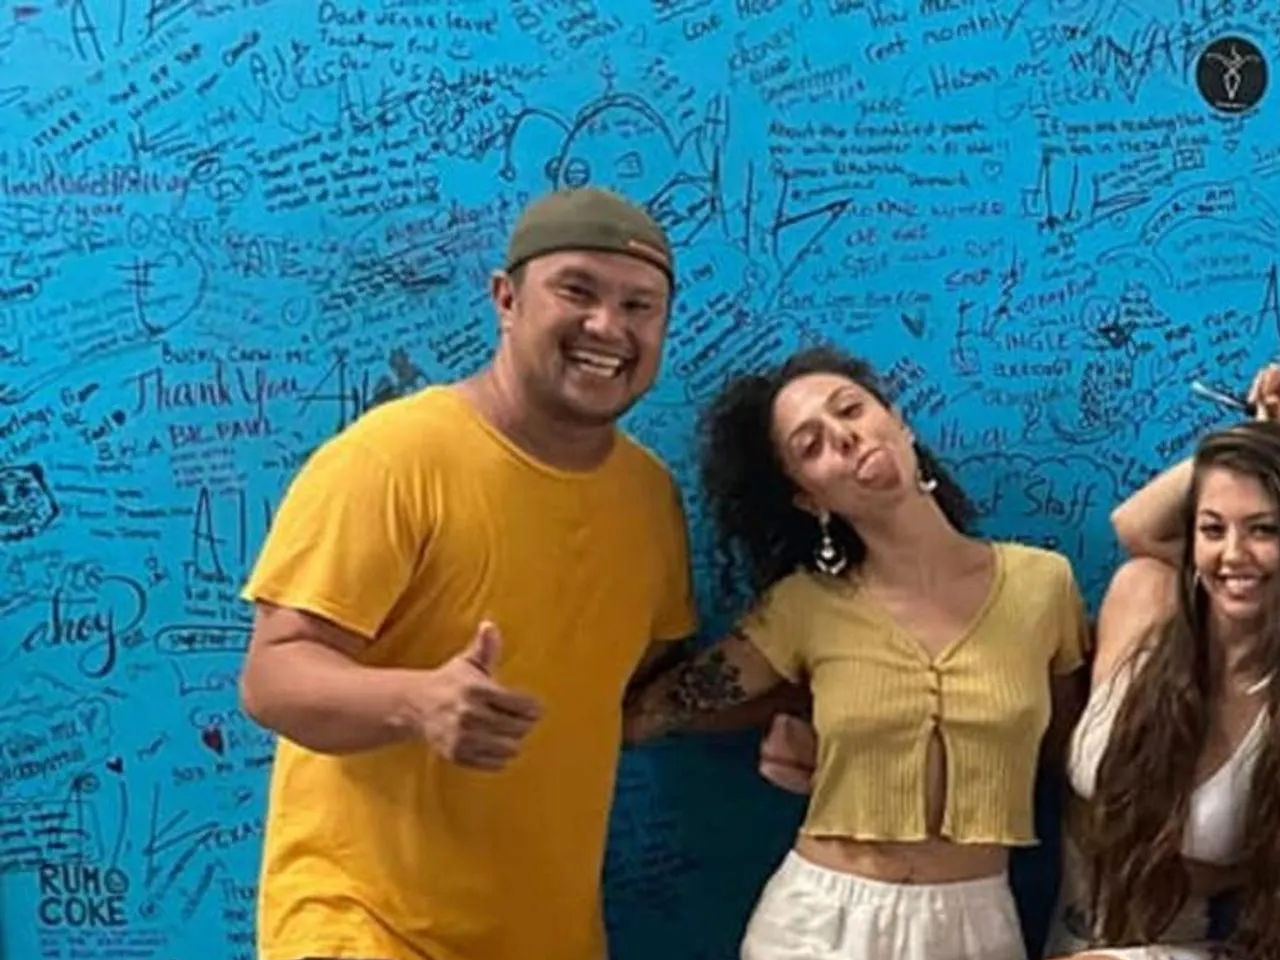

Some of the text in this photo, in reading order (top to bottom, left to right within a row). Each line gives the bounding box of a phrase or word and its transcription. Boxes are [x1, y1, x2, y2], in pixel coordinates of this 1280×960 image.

[122, 360, 299, 424] Thank You
[39, 862, 101, 896] RUM
[38, 896, 129, 926] COKE
